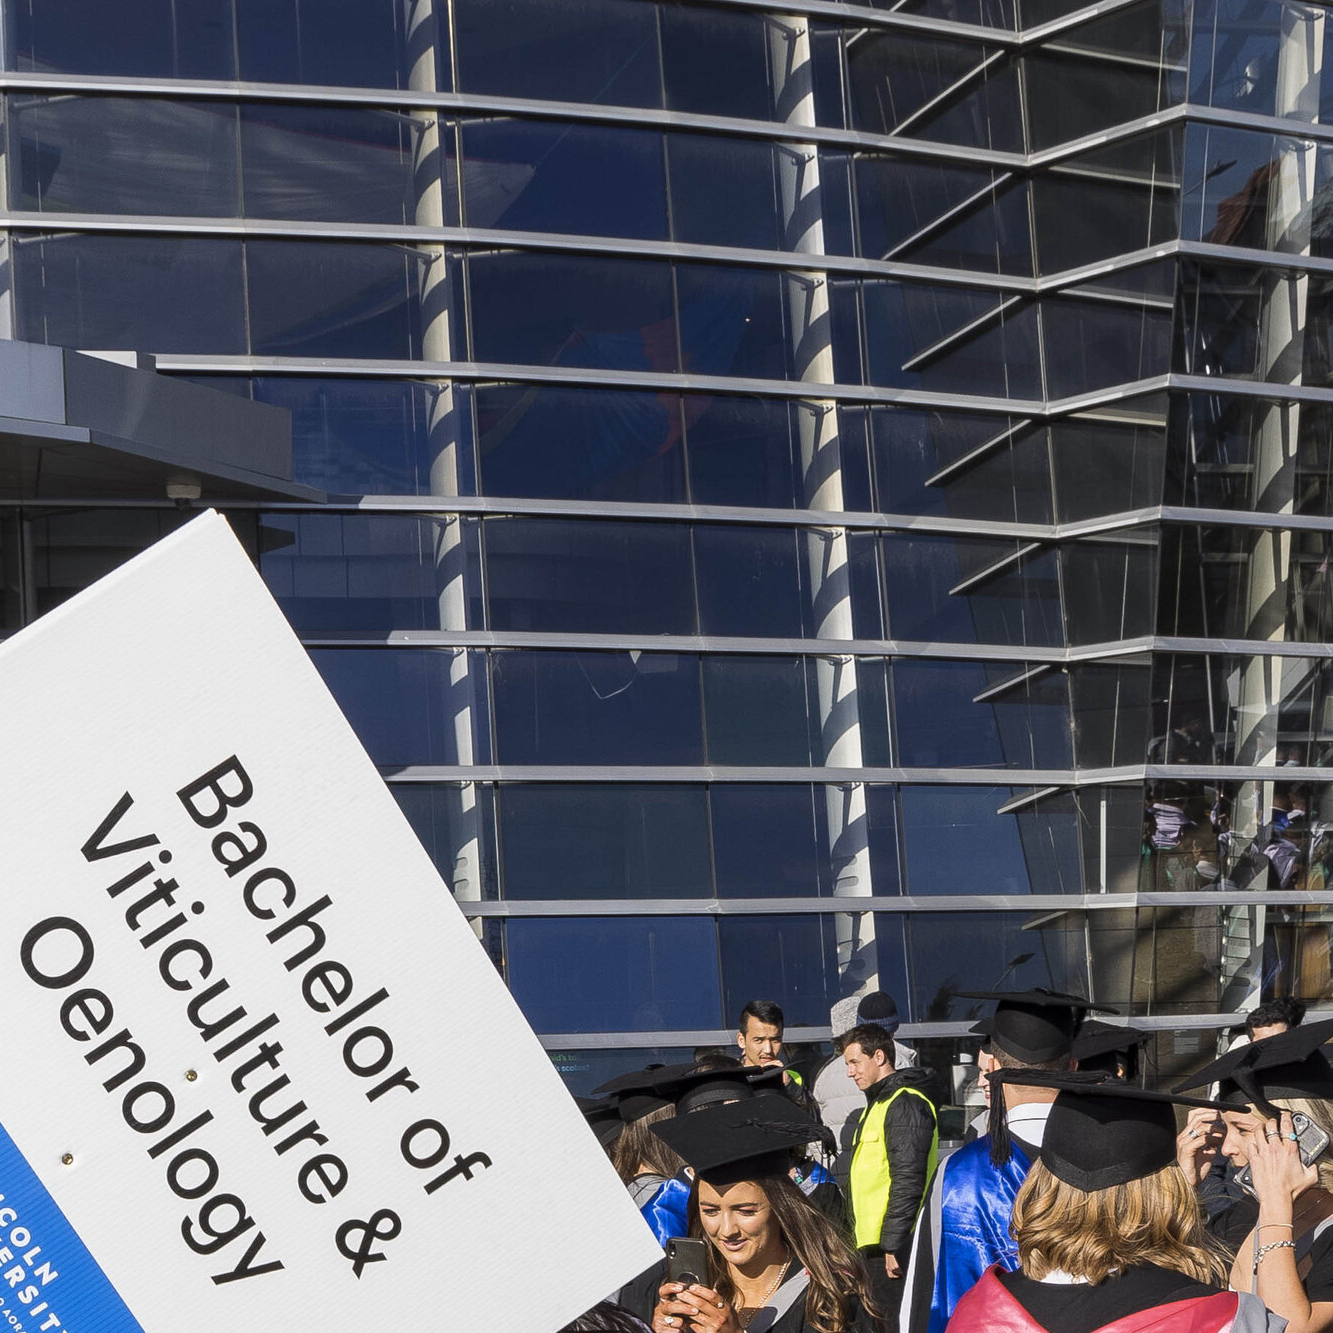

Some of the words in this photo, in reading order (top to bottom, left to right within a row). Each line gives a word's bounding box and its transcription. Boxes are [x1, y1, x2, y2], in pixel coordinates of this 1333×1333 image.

[20, 916, 285, 1286] Oenology
[80, 791, 349, 1204] Viticulture
[335, 1208, 402, 1280] &
[176, 754, 420, 1103] Bachelor
[400, 1118, 493, 1196] of
